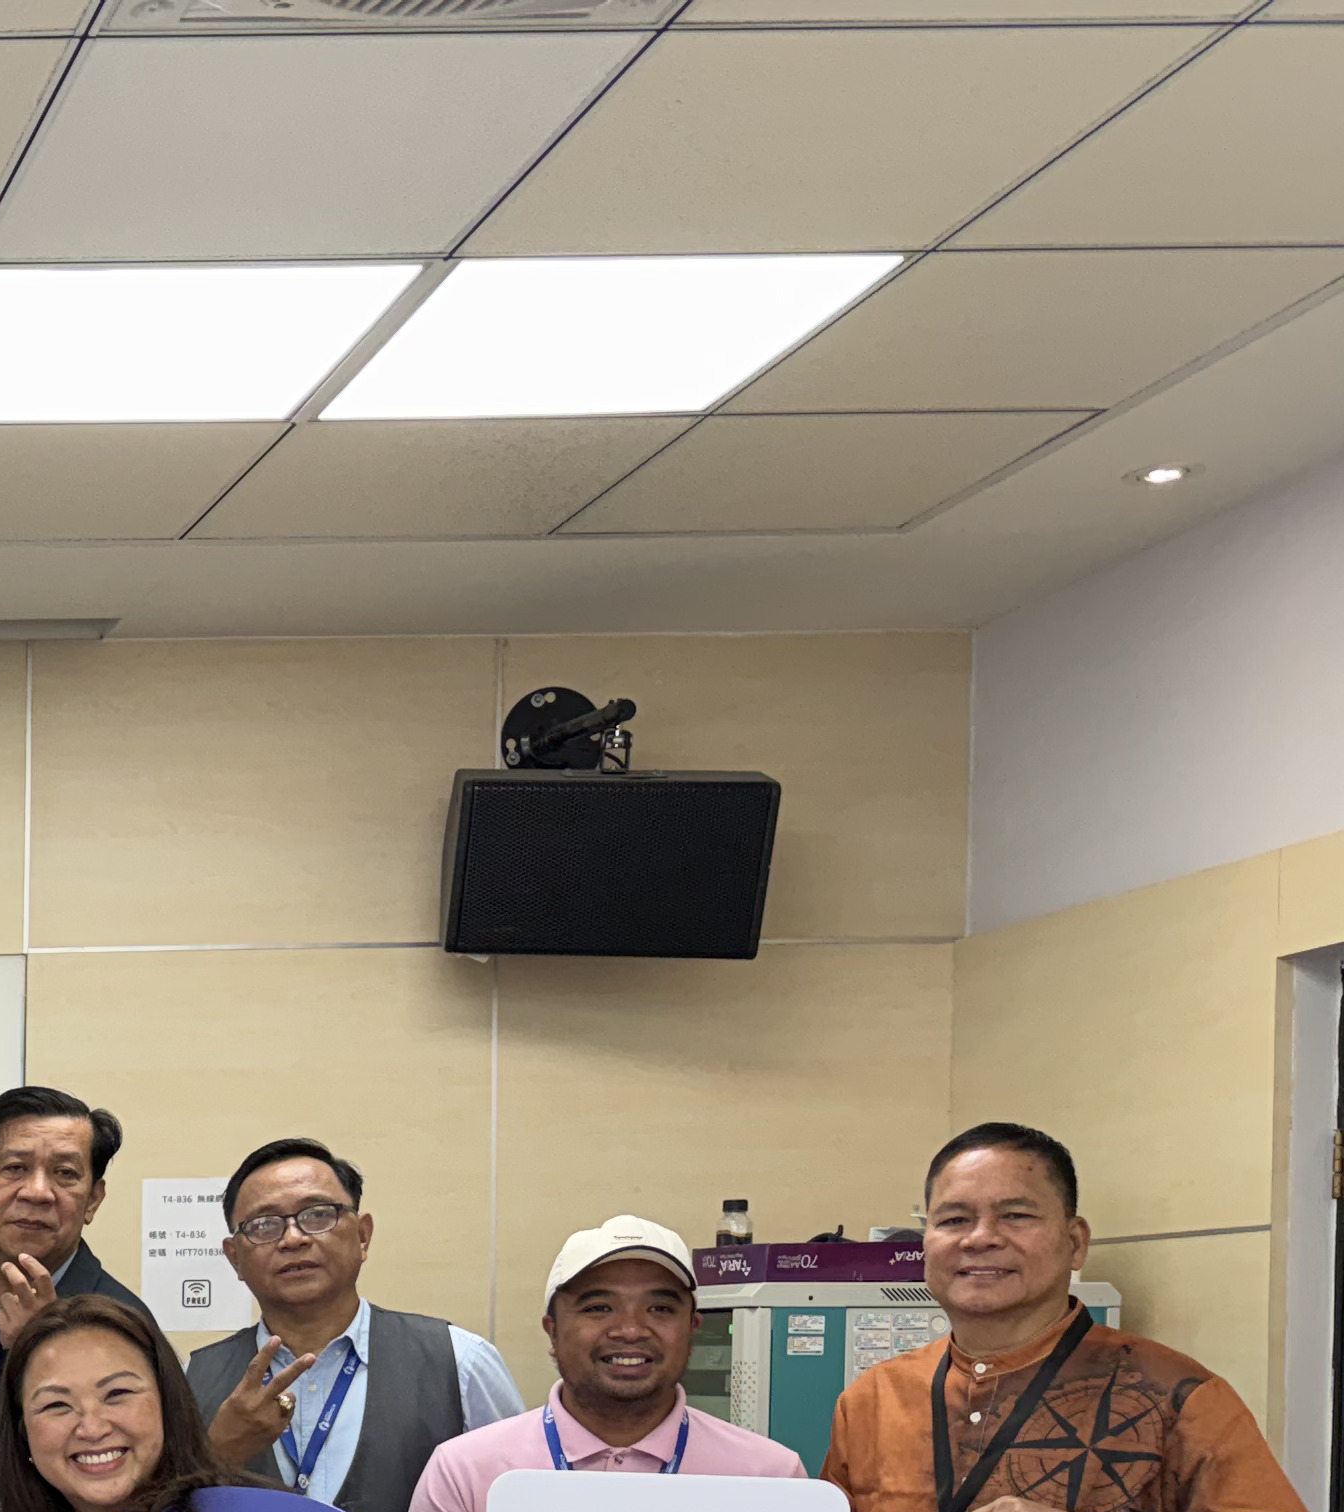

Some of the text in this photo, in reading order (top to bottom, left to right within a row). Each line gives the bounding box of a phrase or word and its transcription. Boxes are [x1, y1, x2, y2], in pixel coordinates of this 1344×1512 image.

[162, 1195, 192, 1203] T4-836
[175, 1230, 206, 1239] T4-836
[800, 1254, 819, 1269] 70
[186, 1297, 207, 1305] FREE
